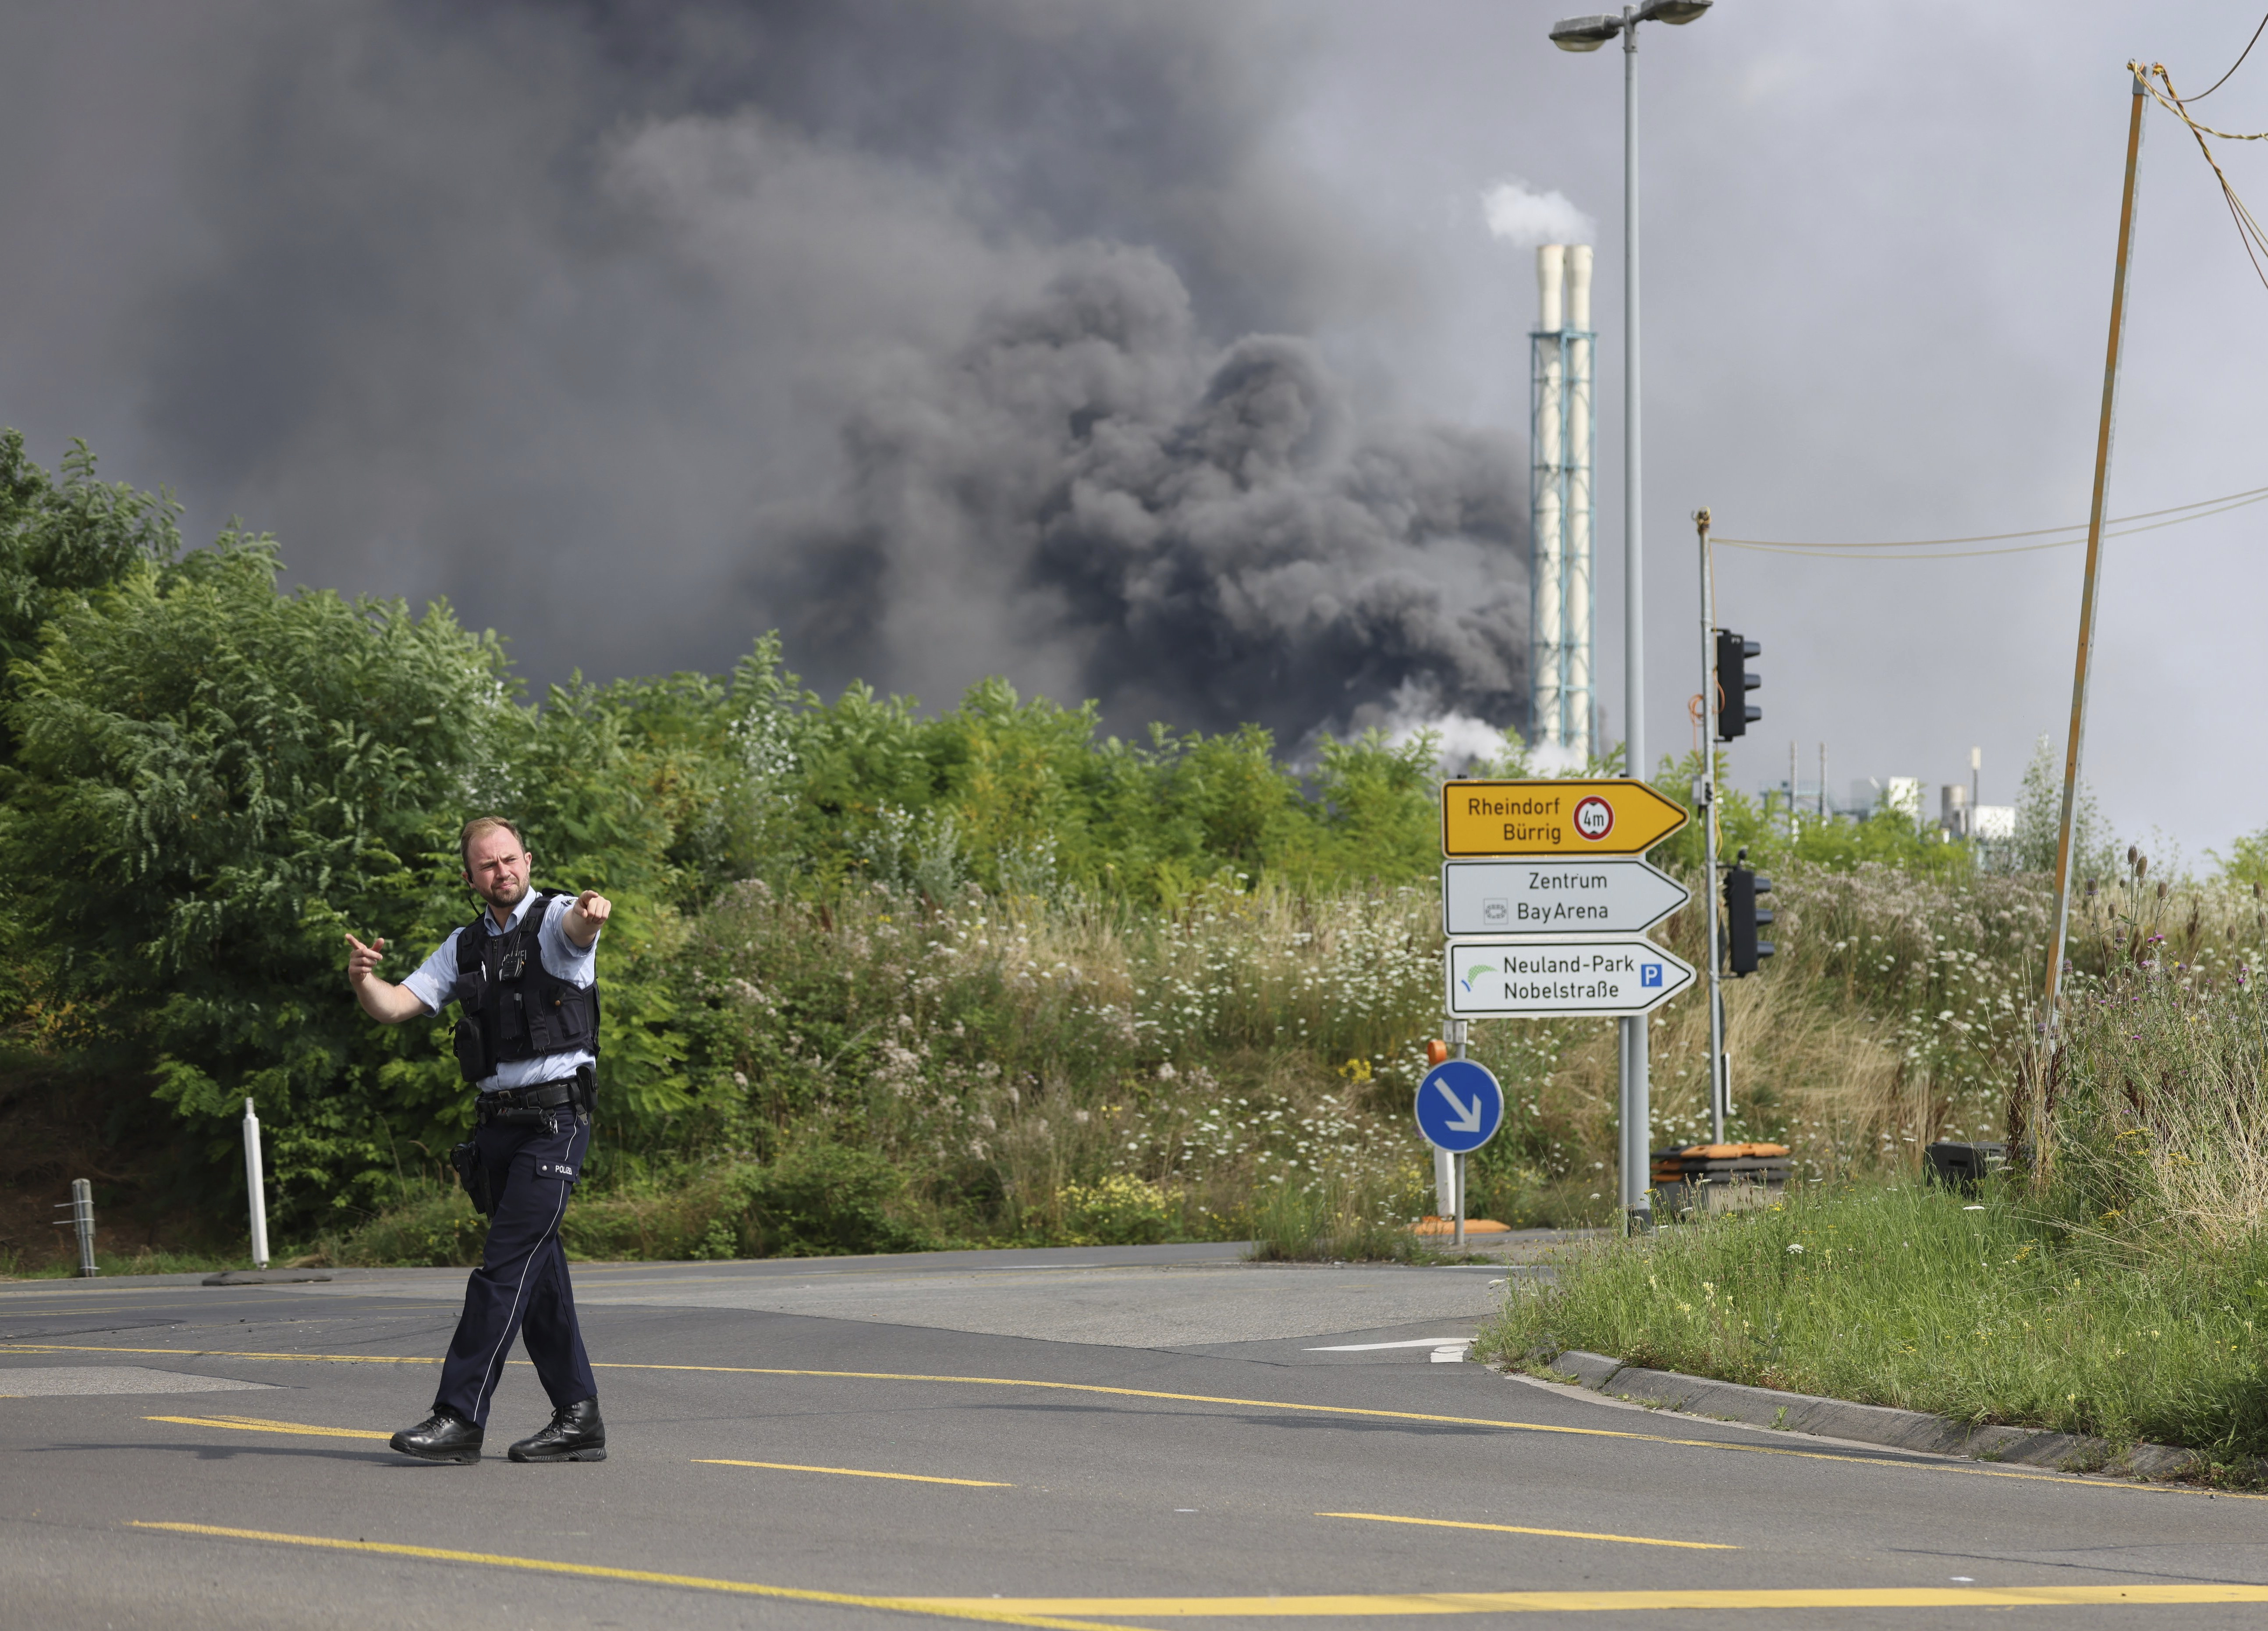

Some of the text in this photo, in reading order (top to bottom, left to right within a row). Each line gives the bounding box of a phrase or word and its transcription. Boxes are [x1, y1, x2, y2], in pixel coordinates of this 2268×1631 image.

[1469, 797, 1560, 816] Rheindorf
[1584, 810, 1604, 827] 4m
[1504, 823, 1561, 845] Bürrig
[1529, 872, 1608, 890] Zentrum
[1518, 903, 1608, 924] BayArena
[1505, 955, 1634, 974] Neuland-Park
[1645, 967, 1658, 985] P
[1505, 981, 1619, 999] Nobelstraße
[555, 1165, 572, 1175] POLIZEI
